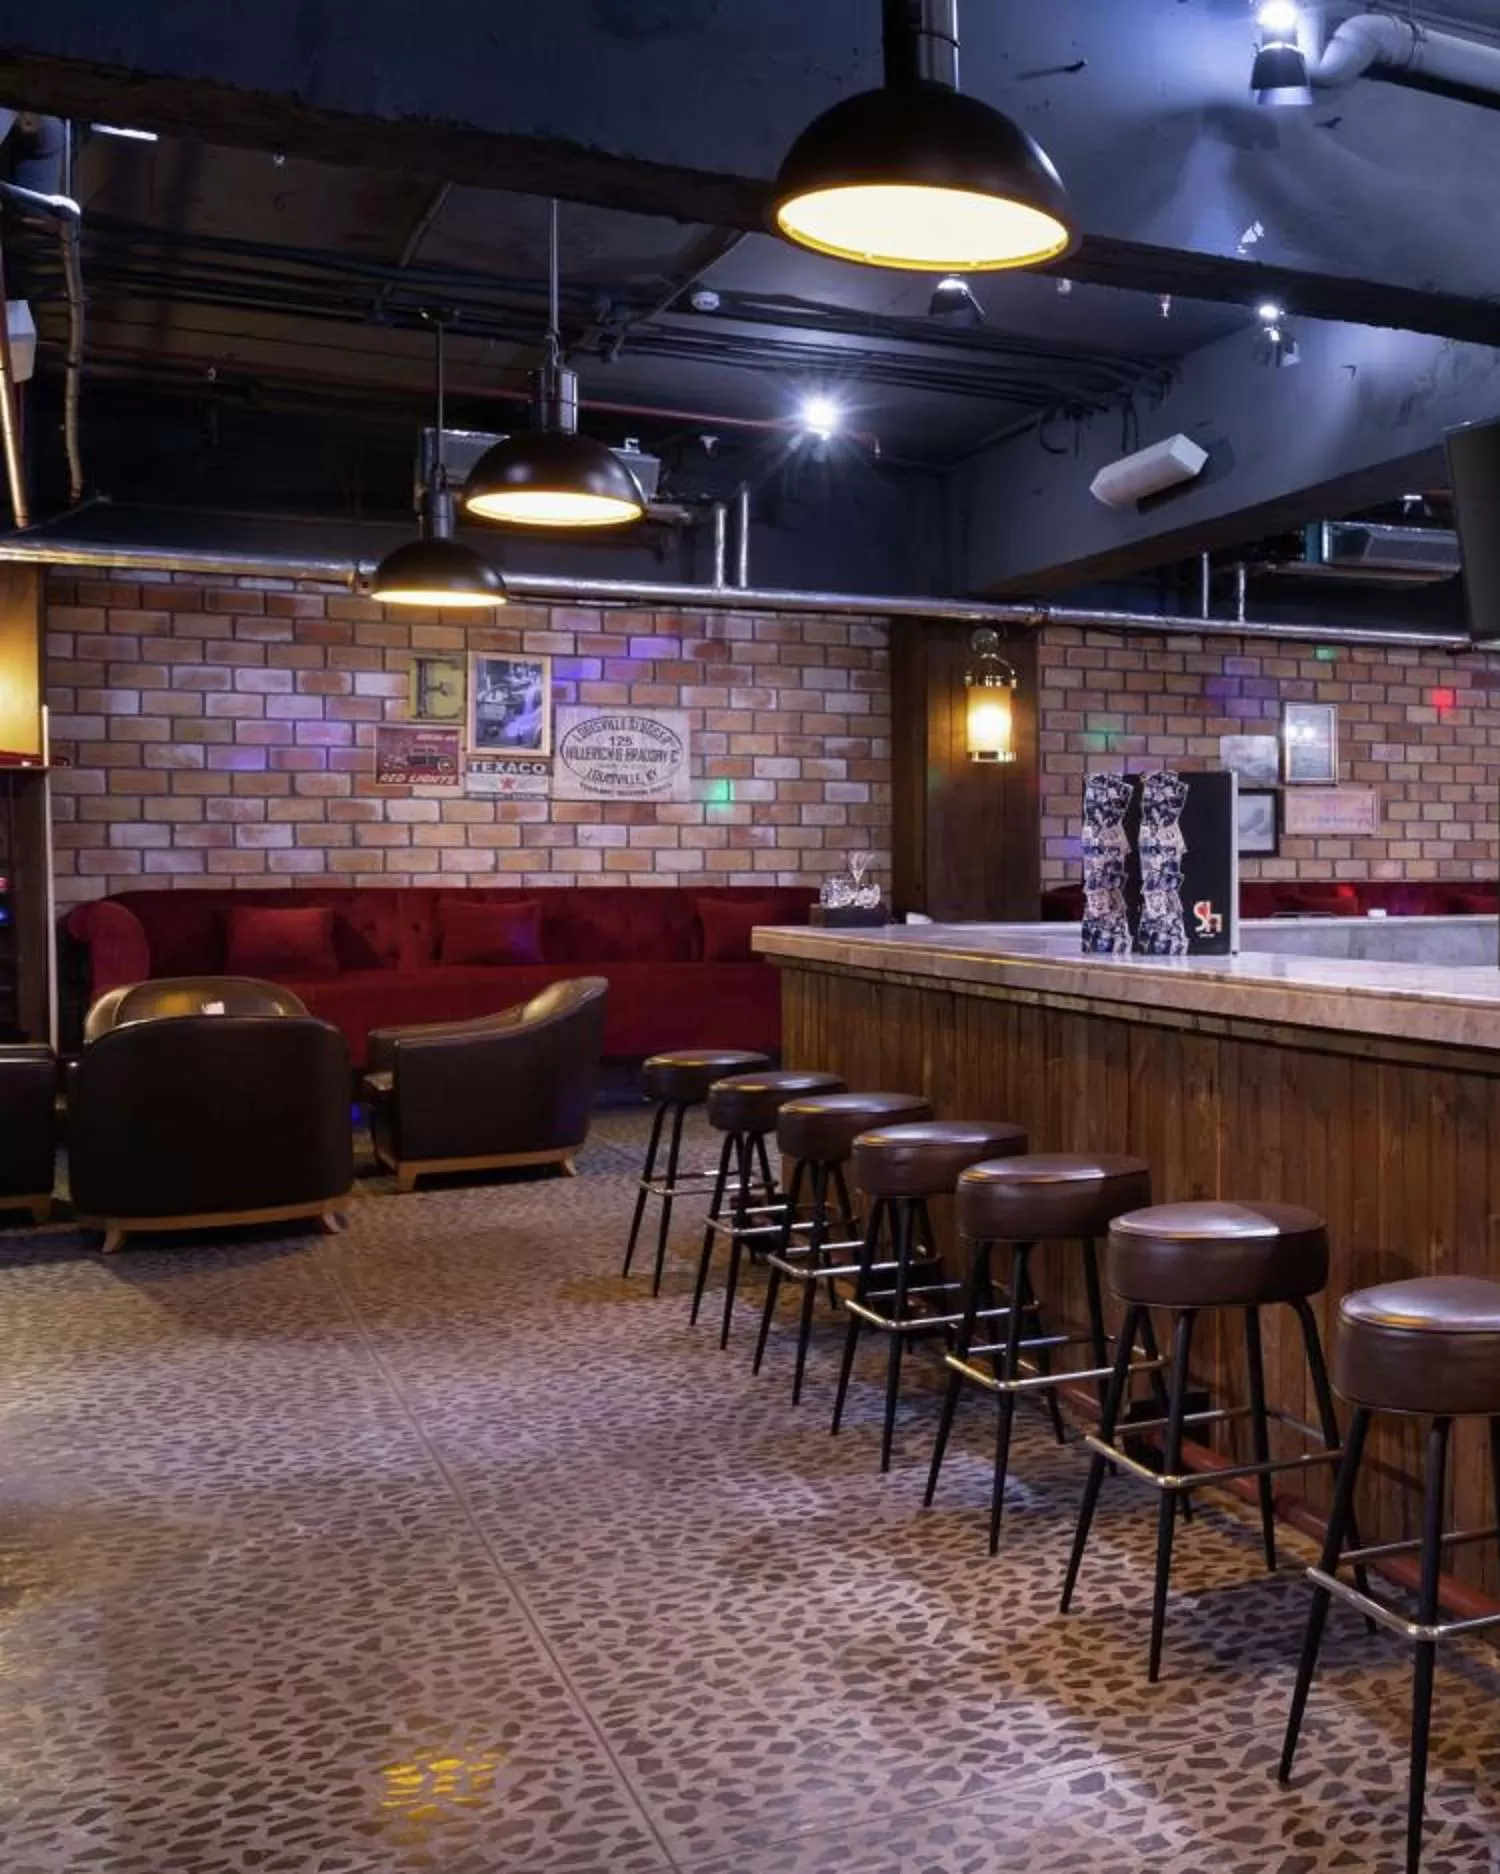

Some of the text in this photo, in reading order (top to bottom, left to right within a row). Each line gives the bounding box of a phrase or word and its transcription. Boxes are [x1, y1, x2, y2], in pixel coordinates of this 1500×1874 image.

[609, 735, 633, 747] 125
[470, 761, 547, 774] TEXACO
[379, 773, 457, 785] RED LIGHTS
